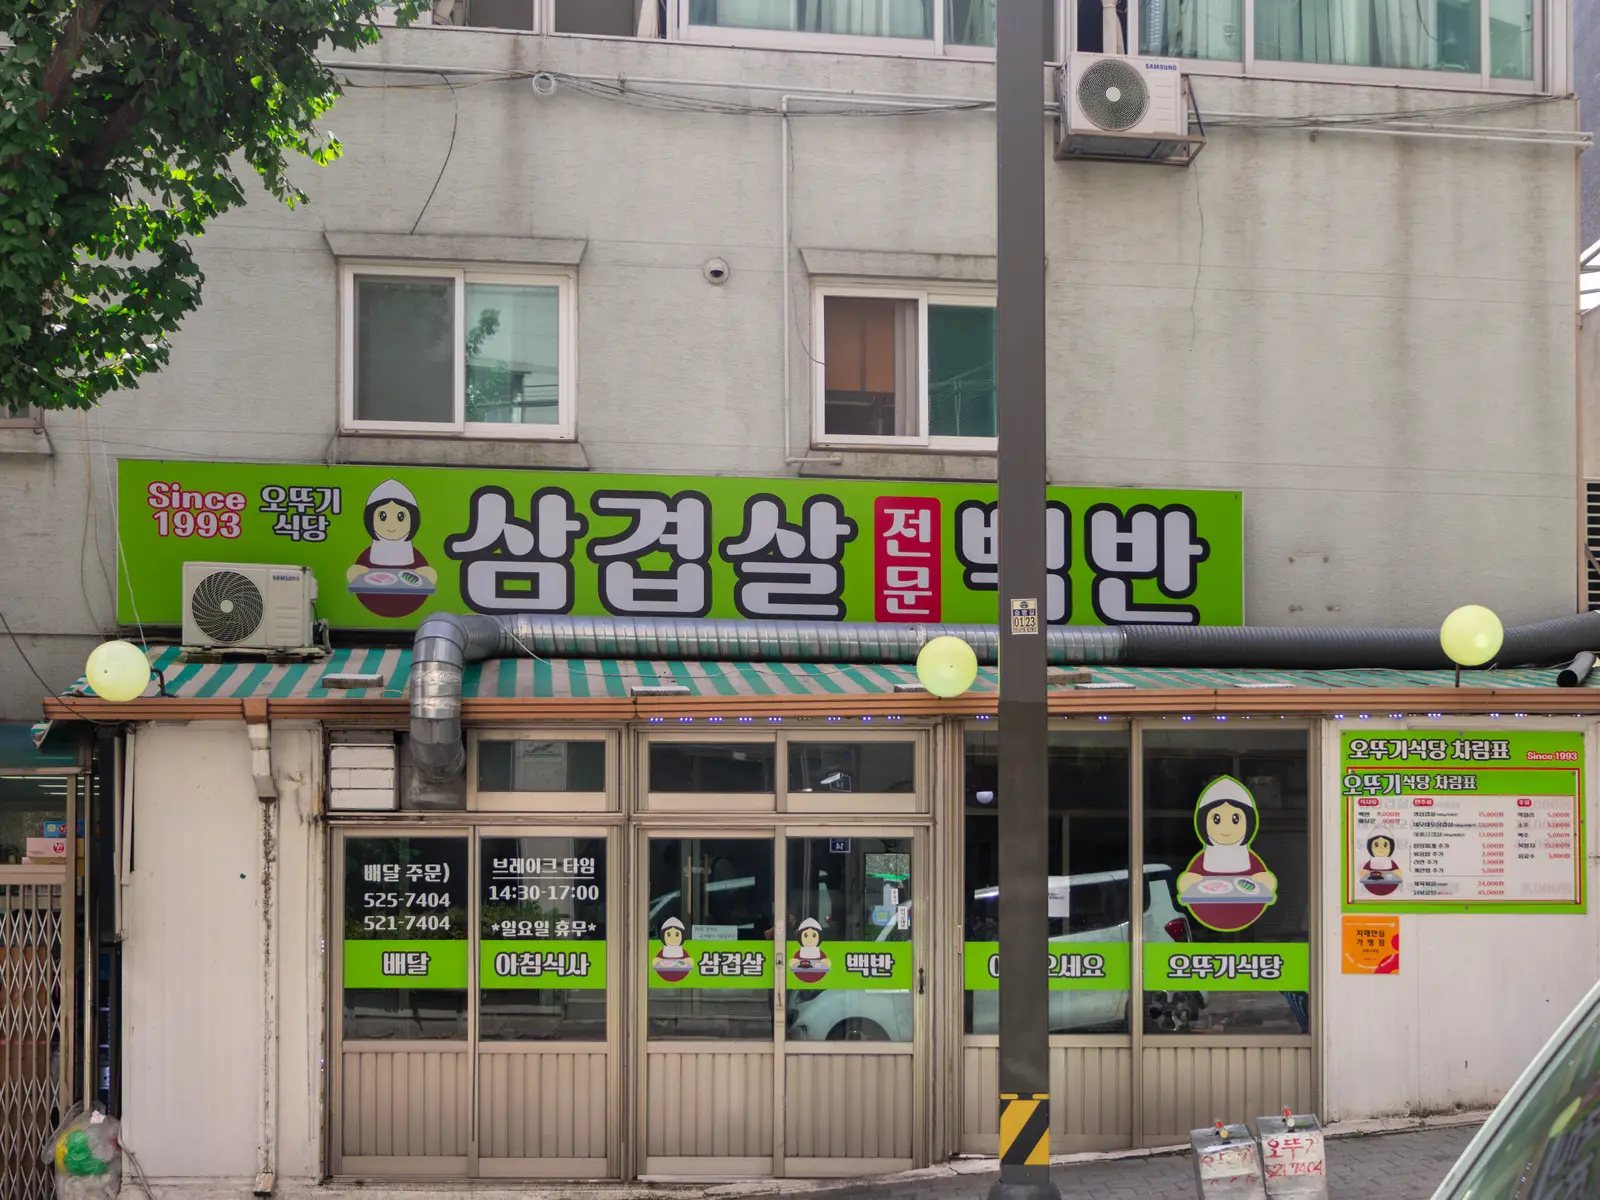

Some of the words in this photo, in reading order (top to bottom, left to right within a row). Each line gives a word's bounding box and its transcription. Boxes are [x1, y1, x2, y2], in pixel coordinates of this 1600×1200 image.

[1145, 63, 1177, 71] SAMSUNG
[147, 481, 247, 511] Since
[259, 485, 342, 515] 오뚜기
[152, 510, 242, 539] 1993
[272, 513, 331, 542] 식당
[444, 485, 858, 622] 삼겹살
[883, 507, 933, 616] 전문
[1348, 738, 1448, 761] 오뚜기식당
[1451, 738, 1511, 761] 차림표
[1526, 750, 1553, 761] Since
[1554, 750, 1579, 761] 1993
[1434, 773, 1478, 791] 차림표
[364, 863, 401, 883] 배달
[405, 862, 450, 883] 주문)
[492, 857, 558, 875] 브레이크
[562, 857, 595, 875] 타임
[363, 892, 451, 908] 525-7404
[488, 884, 599, 901] 14:30-17:00
[363, 915, 451, 931] 521-7404
[1357, 929, 1385, 938] 치매안심
[381, 951, 431, 976] 배달
[494, 952, 590, 977] 아침식사
[698, 951, 766, 977] 삼겹살
[845, 952, 895, 978] 백반
[1167, 953, 1284, 980] 오뚜기식당
